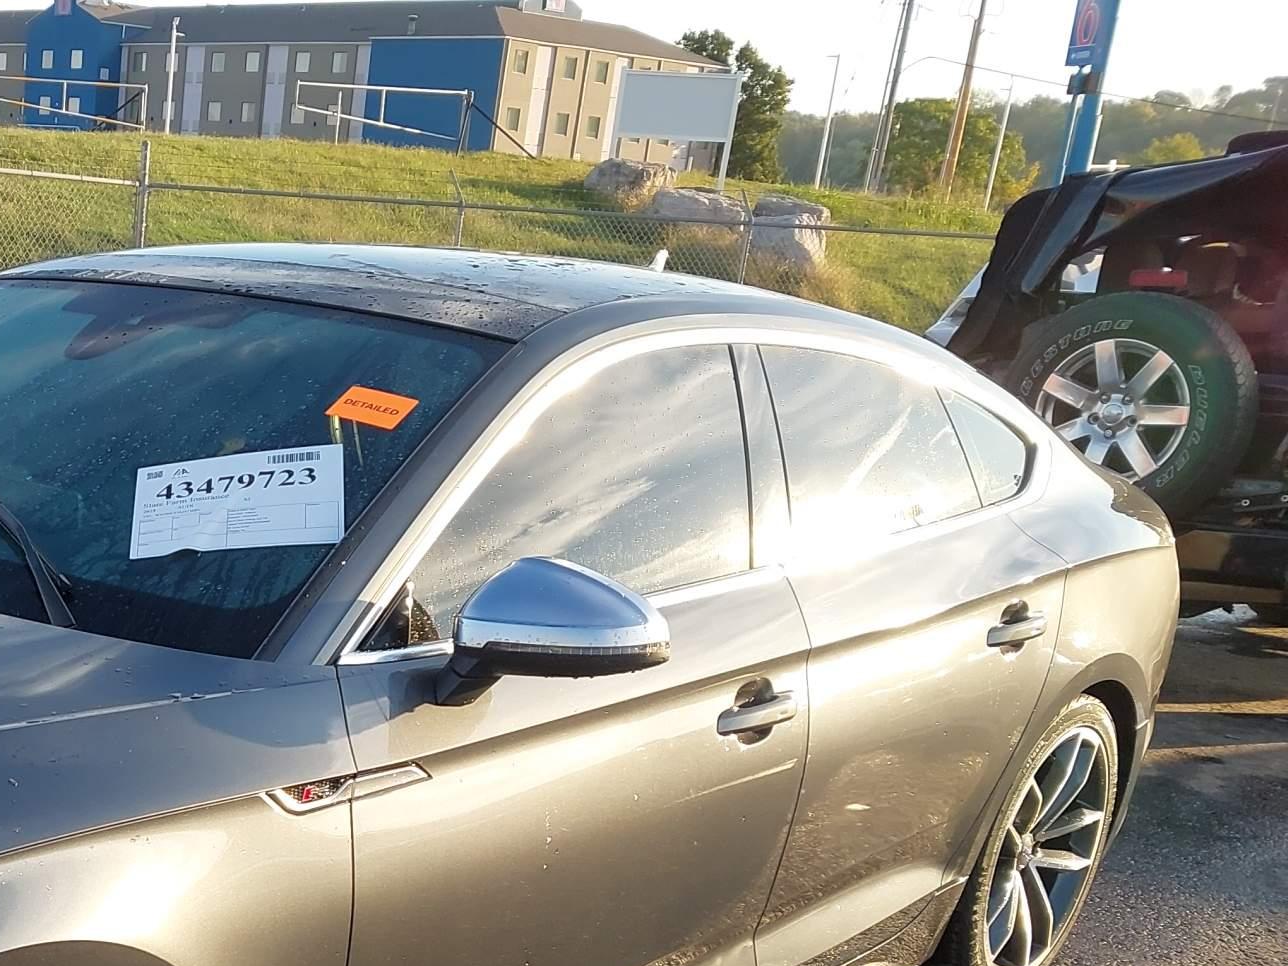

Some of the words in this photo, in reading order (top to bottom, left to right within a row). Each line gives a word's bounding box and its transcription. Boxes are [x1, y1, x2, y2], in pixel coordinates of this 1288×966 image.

[1077, 0, 1099, 46] 6
[1015, 319, 1133, 401] GESTONE
[343, 398, 400, 416] DETAILED
[155, 466, 317, 500] 43479723
